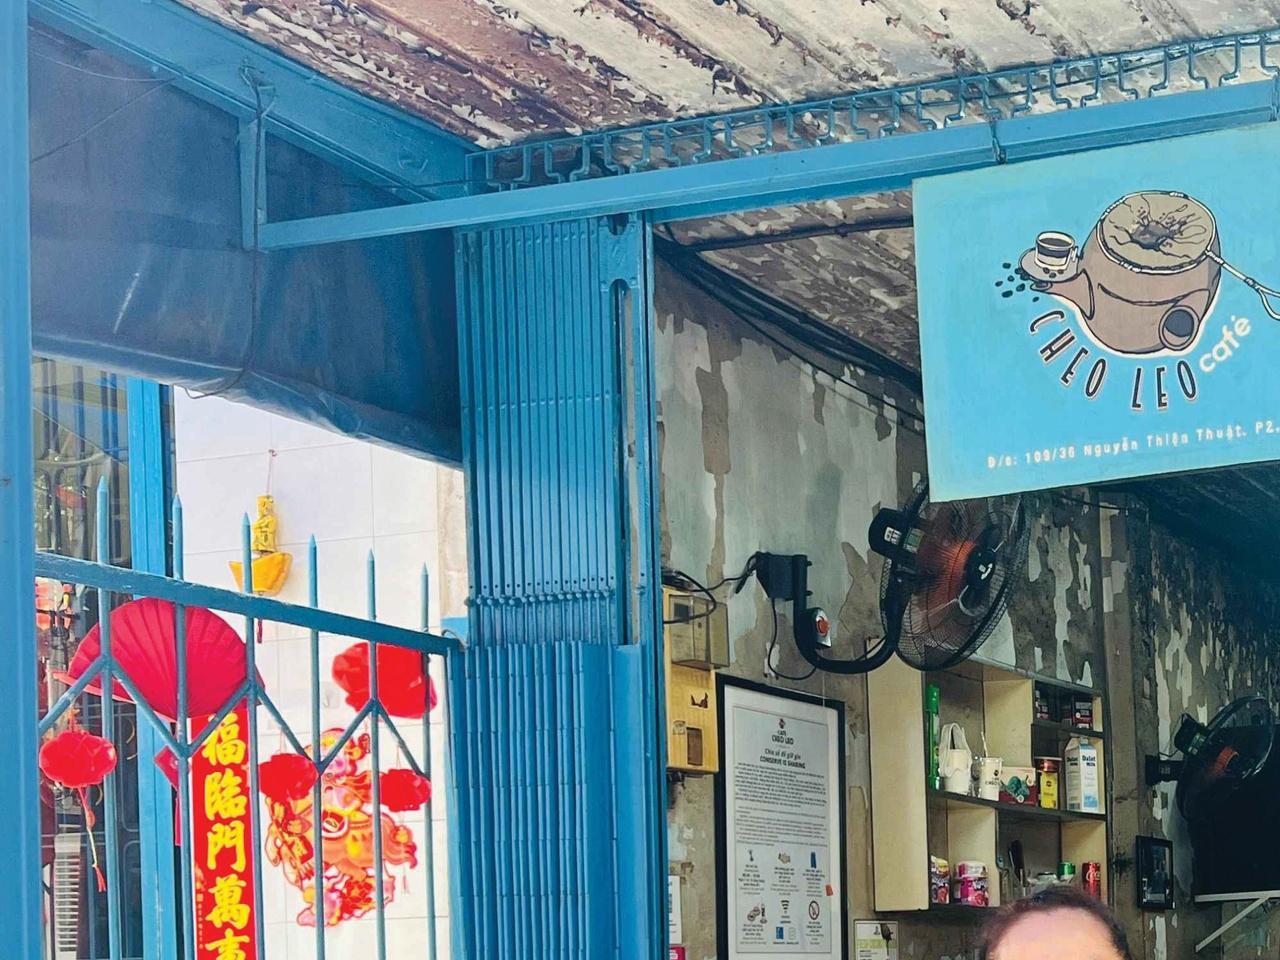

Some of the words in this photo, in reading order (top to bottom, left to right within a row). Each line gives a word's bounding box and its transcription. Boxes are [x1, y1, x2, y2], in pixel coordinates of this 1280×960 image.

[1029, 309, 1107, 398] CHEO
[1131, 359, 1198, 409] LEO
[1198, 314, 1252, 373] café
